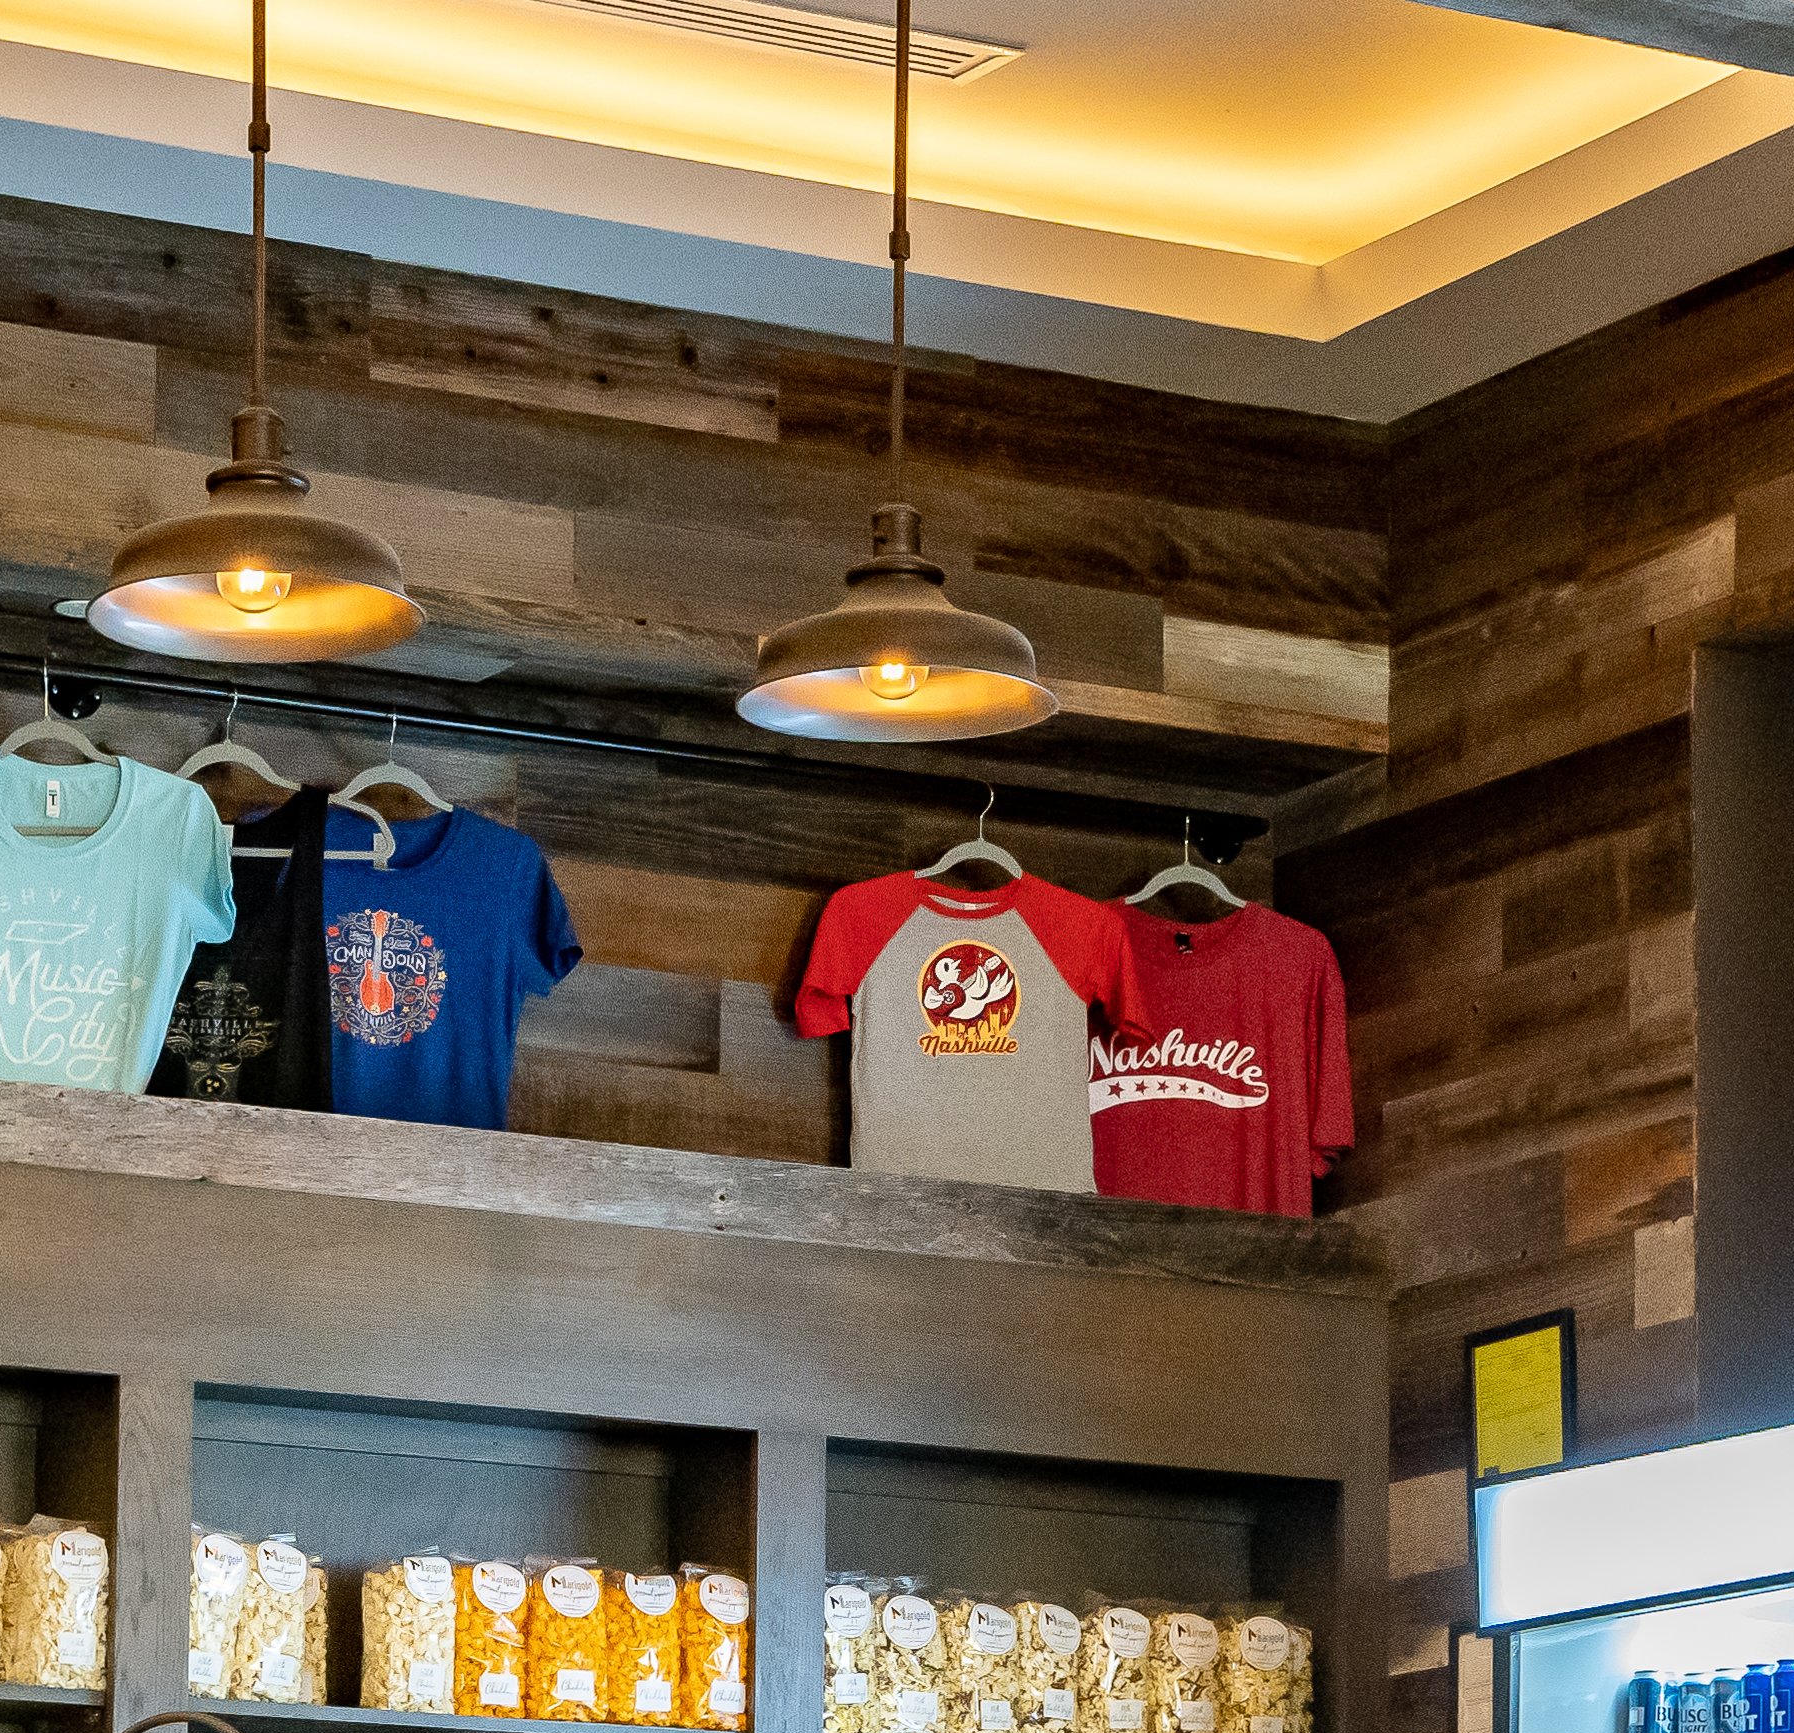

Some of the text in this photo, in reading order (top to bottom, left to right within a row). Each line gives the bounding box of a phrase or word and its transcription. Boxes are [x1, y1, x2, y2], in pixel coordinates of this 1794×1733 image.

[23, 996, 118, 1081] City
[920, 1032, 1019, 1055] Nashville
[1088, 1028, 1264, 1084] Nashville
